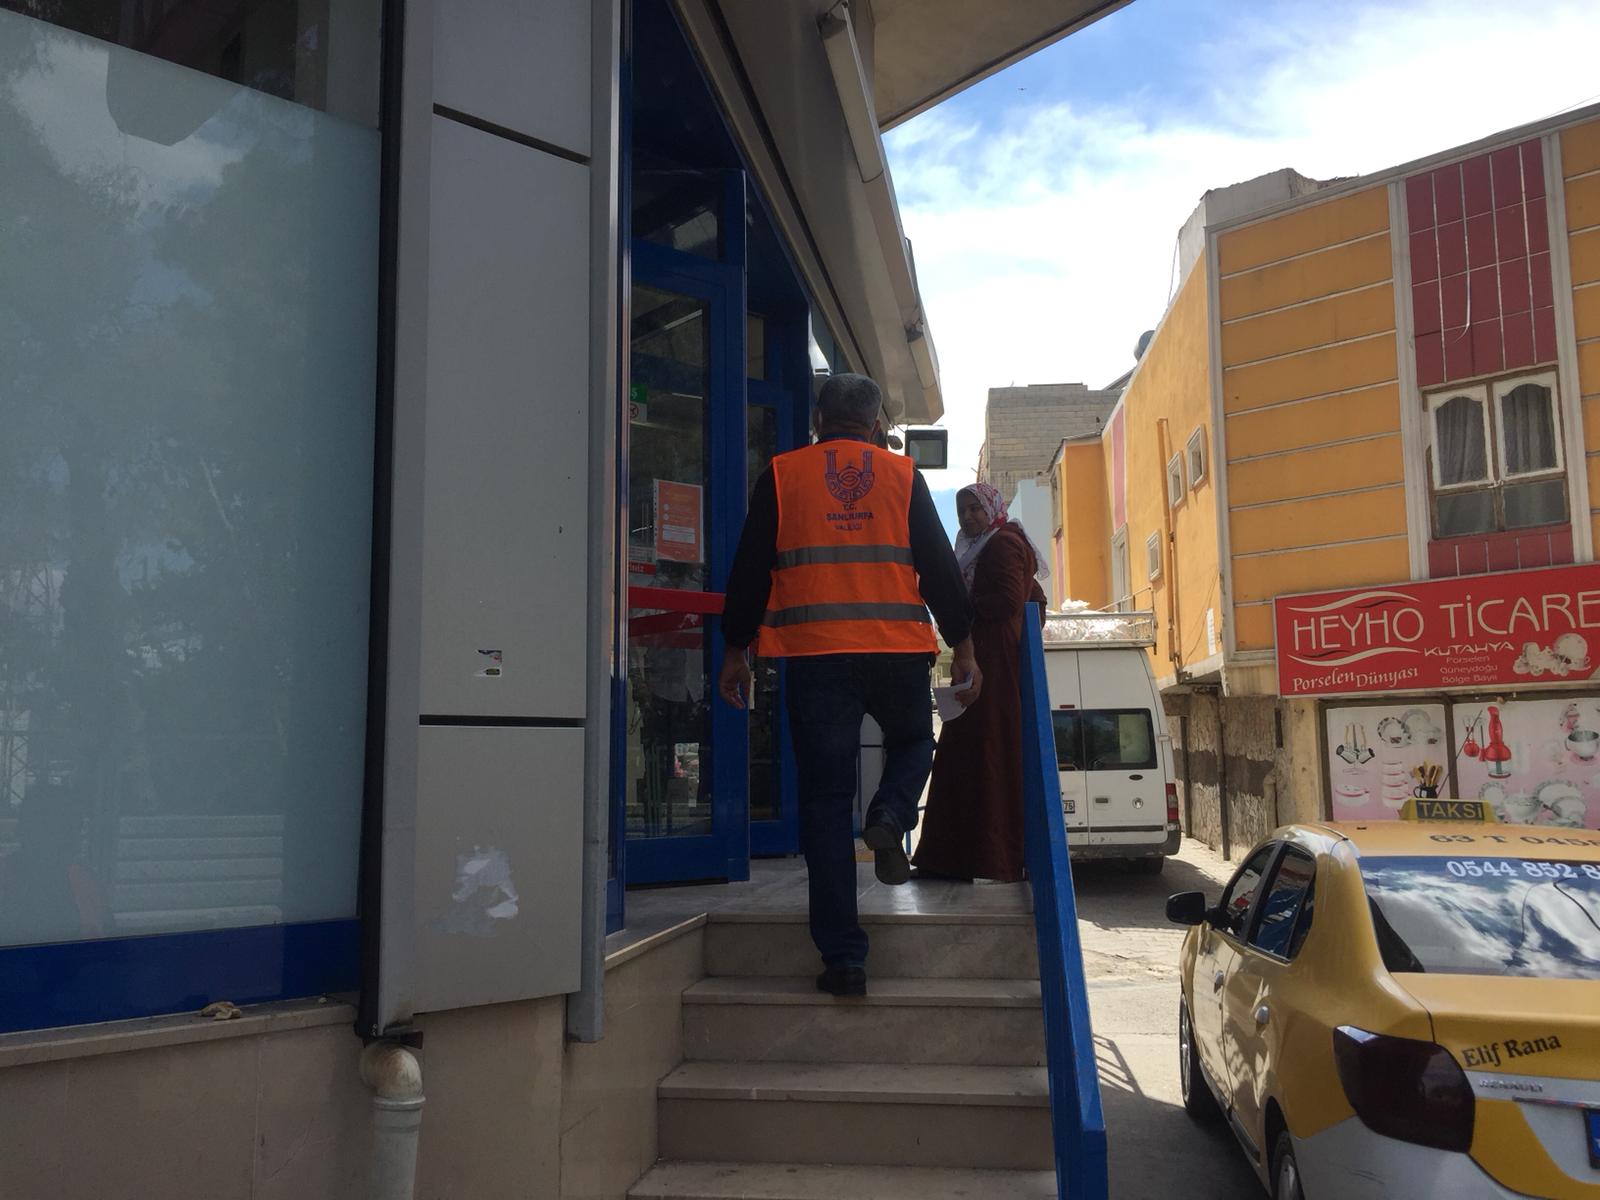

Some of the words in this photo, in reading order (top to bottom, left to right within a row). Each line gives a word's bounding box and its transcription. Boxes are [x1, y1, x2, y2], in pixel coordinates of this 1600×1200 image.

[1293, 607, 1425, 651] HEYHO
[1292, 667, 1355, 692] Porselen
[1356, 667, 1419, 688] Dünyası
[1429, 834, 1475, 843] 63
[1483, 835, 1508, 843] T
[1447, 860, 1518, 877] 0544
[1522, 861, 1578, 879] 852
[1581, 864, 1600, 880] 8
[1462, 1043, 1502, 1067] Elif
[1504, 1035, 1562, 1058] Rana
